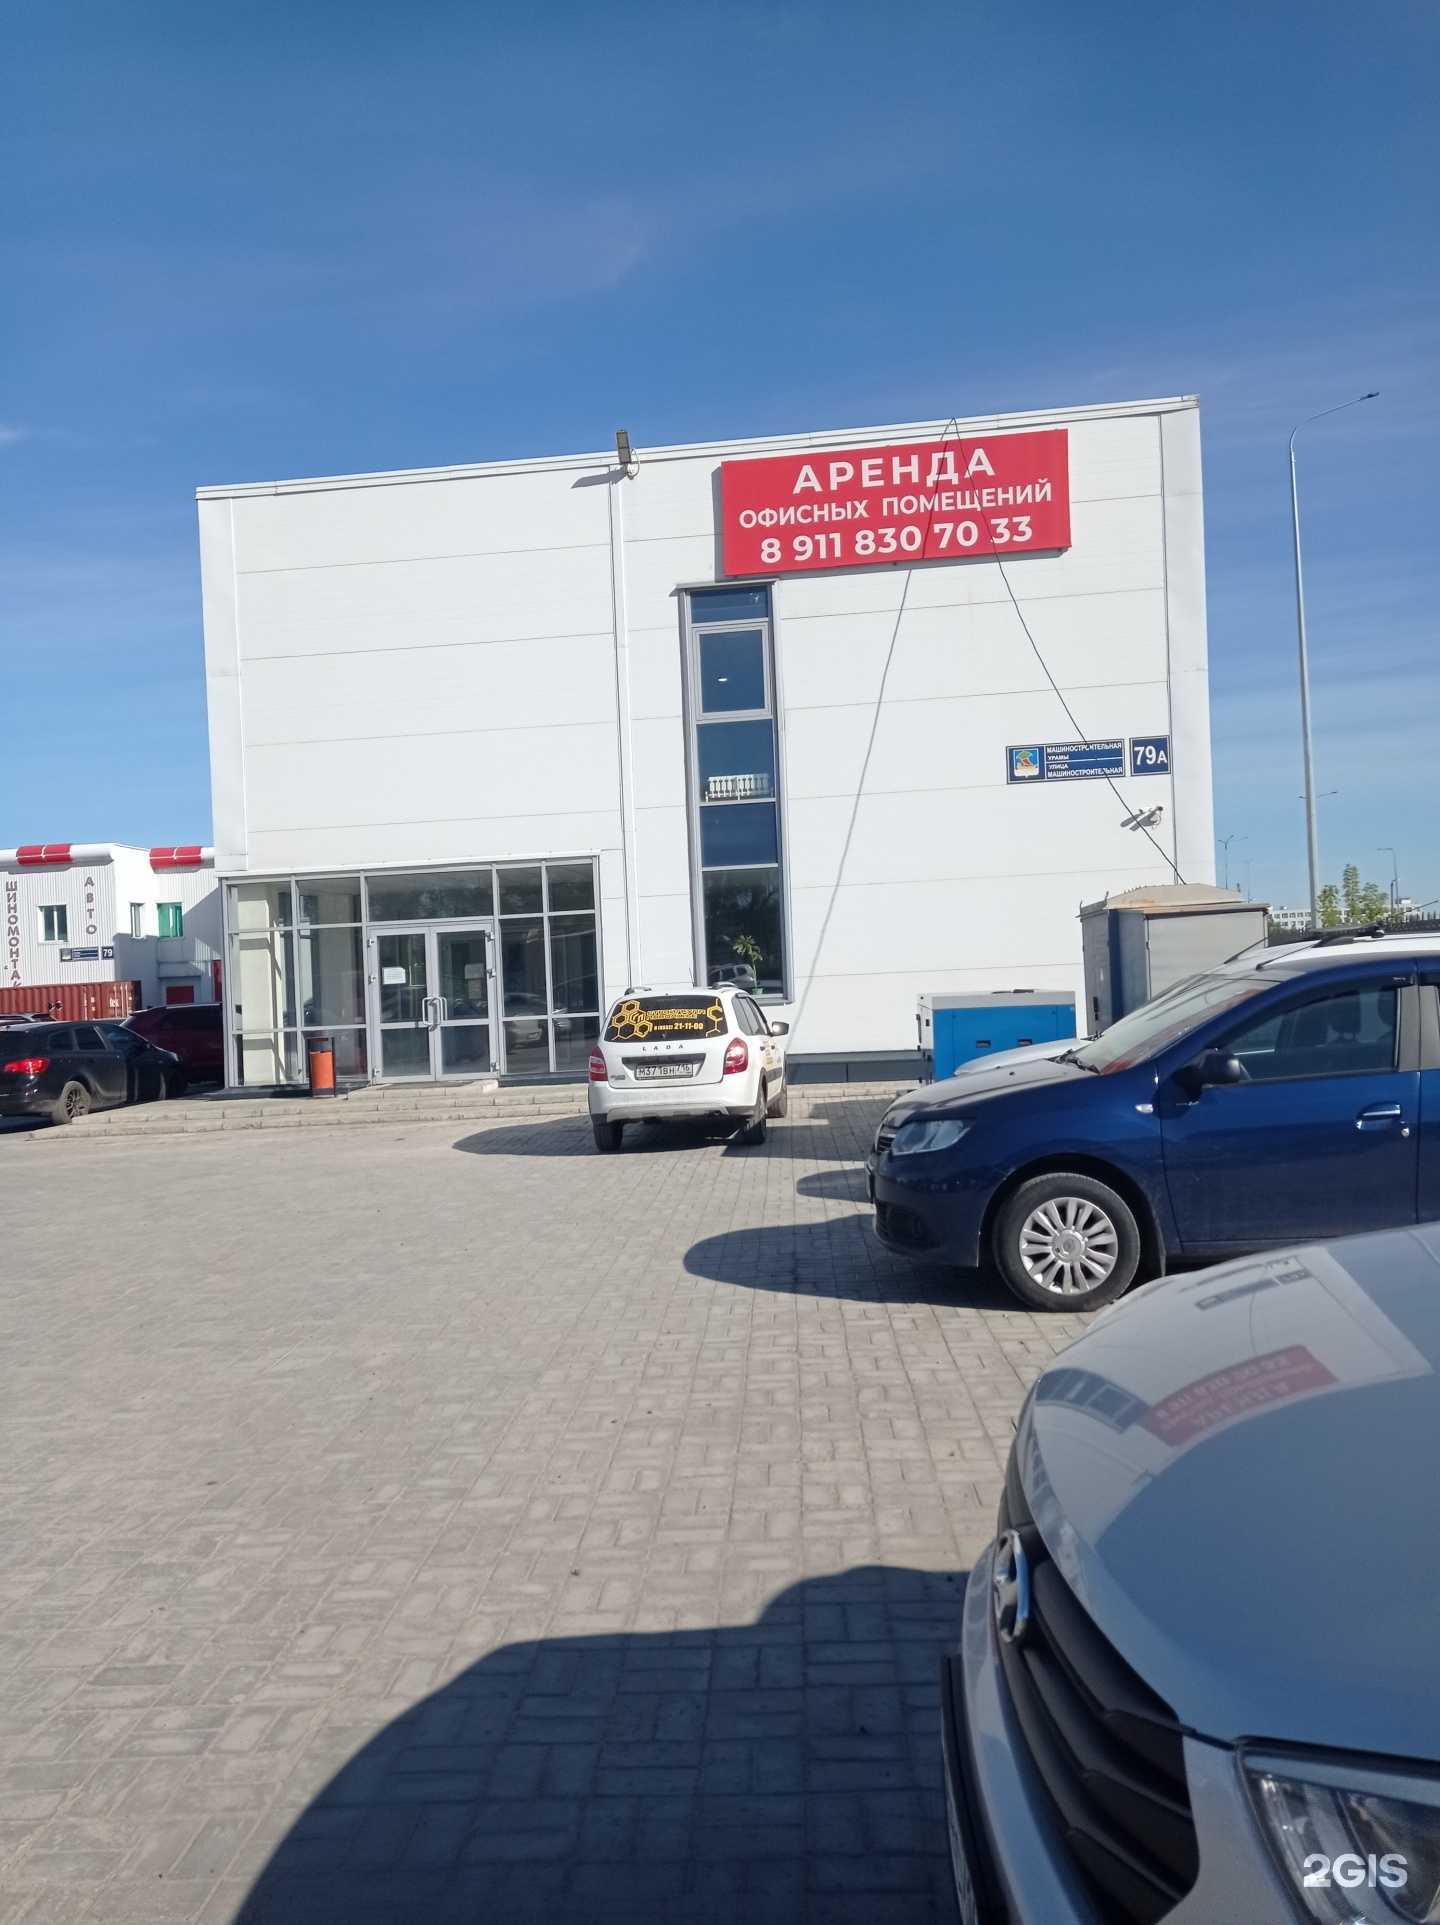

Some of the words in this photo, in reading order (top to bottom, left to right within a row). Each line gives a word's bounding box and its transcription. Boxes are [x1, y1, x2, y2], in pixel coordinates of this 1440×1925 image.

[793, 448, 997, 495] АРЕНДА
[738, 499, 870, 529] ОФИСНЫХ
[882, 478, 1053, 516] ПОМЕЩЕНИЙ
[759, 536, 783, 564] 8
[792, 532, 843, 562] 911
[854, 526, 922, 556] 830
[933, 520, 979, 549] 70
[989, 515, 1033, 544] 33
[1133, 746, 1168, 766] 79А
[84, 876, 98, 935] АВТО
[102, 948, 113, 957] 79
[642, 1044, 684, 1052] LADA
